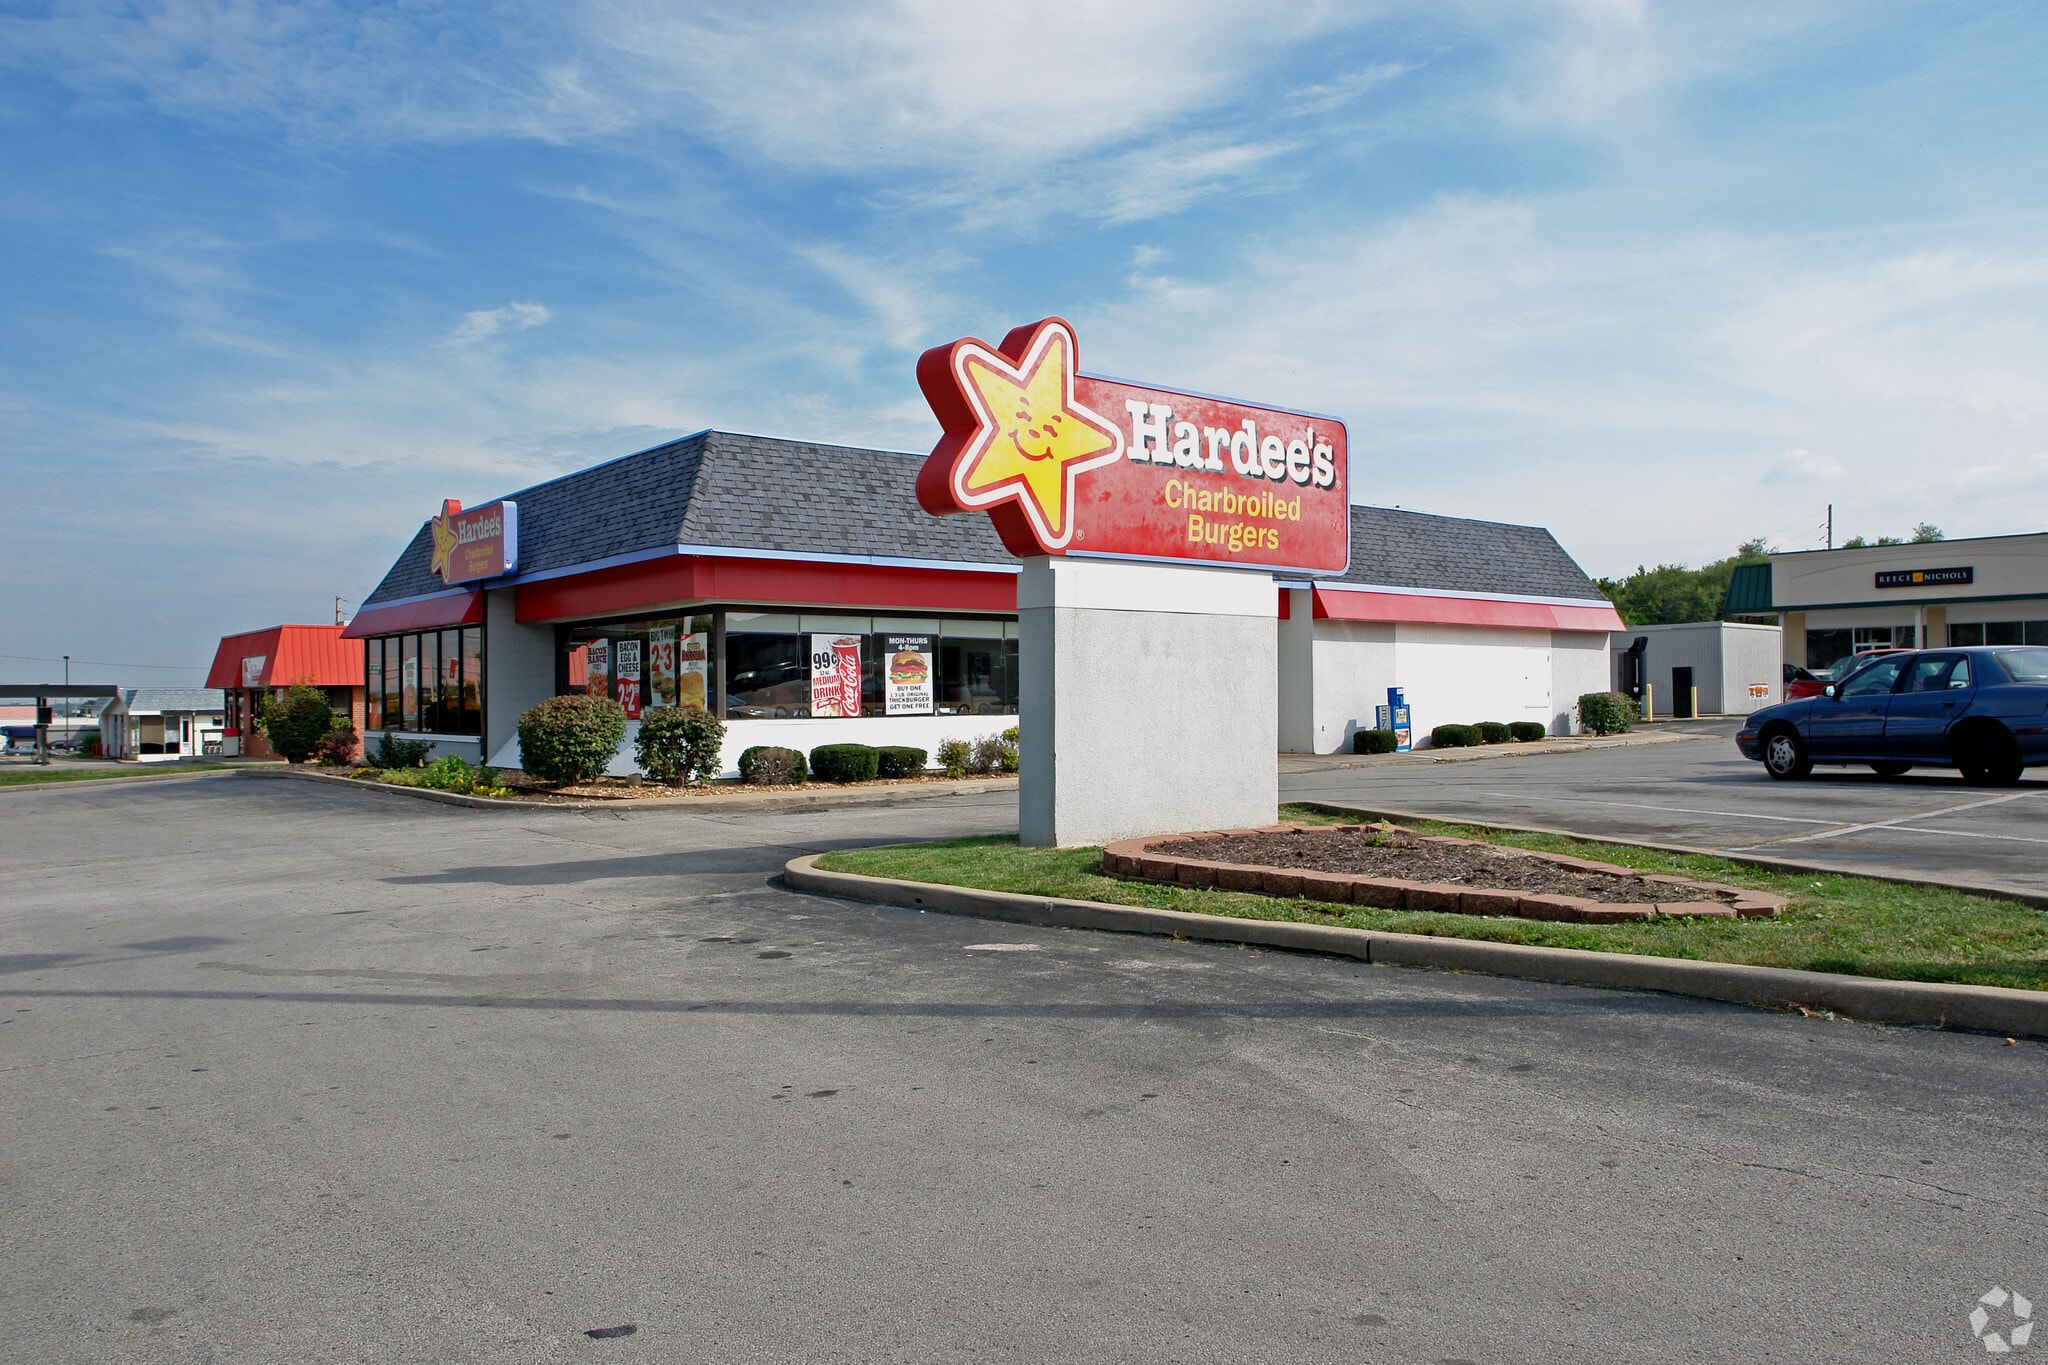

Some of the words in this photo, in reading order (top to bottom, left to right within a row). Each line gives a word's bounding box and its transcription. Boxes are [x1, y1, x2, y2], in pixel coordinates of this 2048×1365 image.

[1125, 399, 1335, 488] Hardee's
[1165, 479, 1301, 522] Charbroiled
[458, 511, 501, 545] Hardee's
[1188, 514, 1280, 553] Burgers
[1879, 575, 1911, 583] REECE
[1924, 571, 1968, 581] NICHOLS
[619, 641, 639, 652] BACON
[889, 637, 928, 645] MON-THURS
[587, 646, 607, 656] BACON
[620, 652, 631, 662] EGG
[633, 652, 637, 662] &
[587, 655, 607, 665] RANCH
[651, 644, 660, 672] 2
[618, 662, 639, 673] CHEESE
[813, 674, 840, 687] MEDIUM
[813, 686, 841, 699] DRINK
